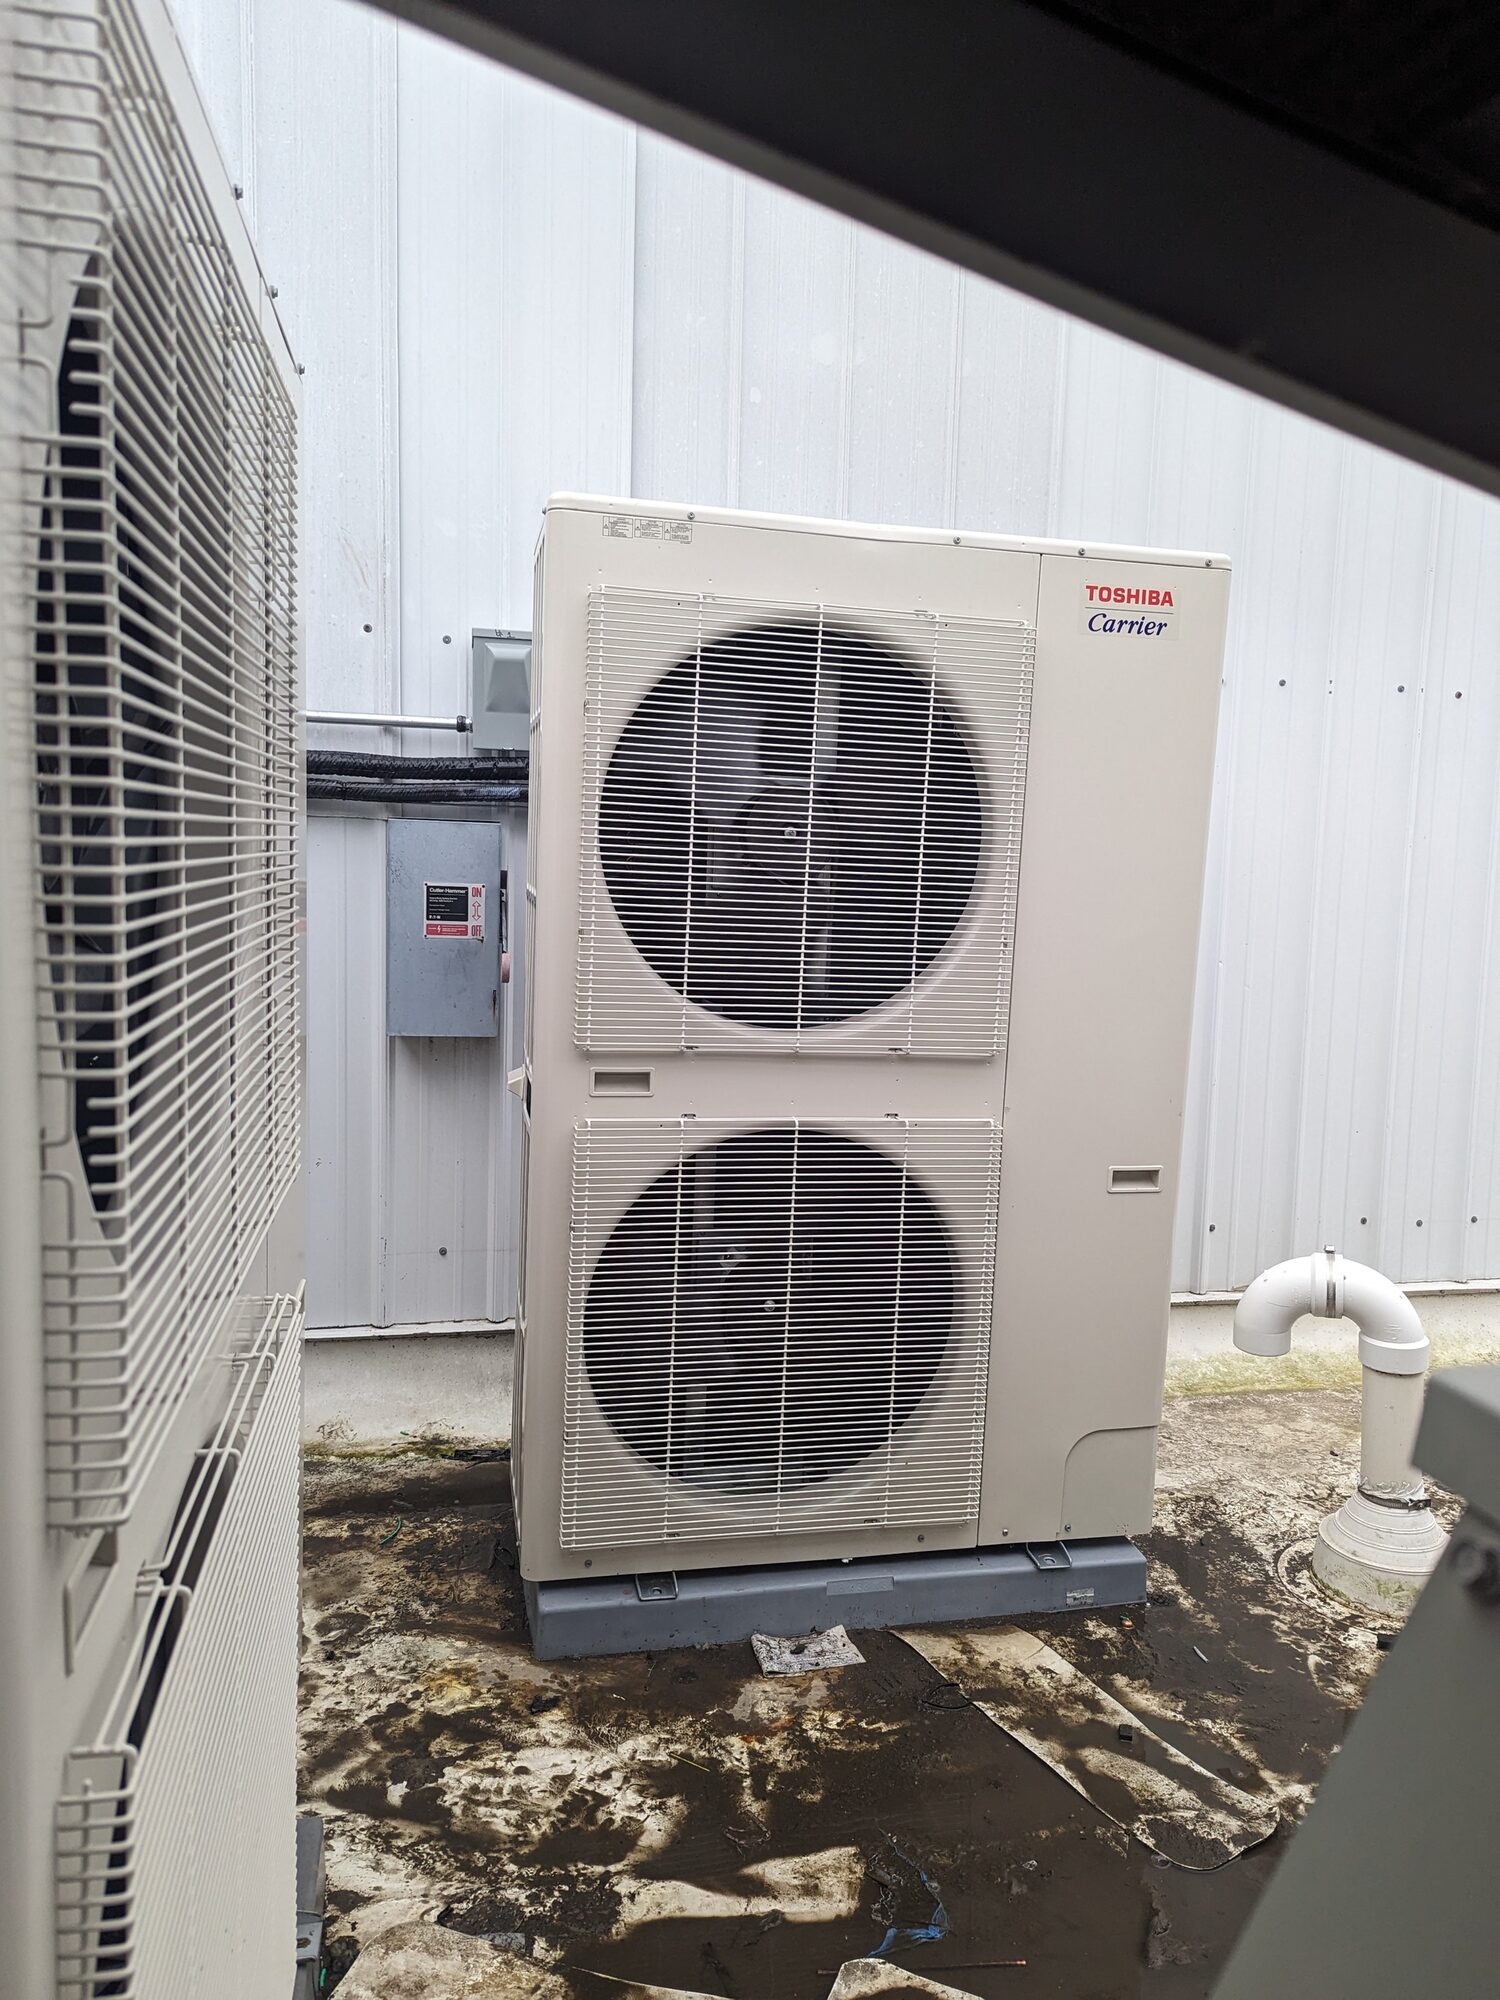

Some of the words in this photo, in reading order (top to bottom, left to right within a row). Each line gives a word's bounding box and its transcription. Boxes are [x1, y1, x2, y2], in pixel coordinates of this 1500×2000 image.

[1086, 585, 1174, 607] TOSHIBA
[1088, 613, 1167, 636] Carrier
[472, 887, 482, 898] ON
[471, 925, 482, 937] OFF
